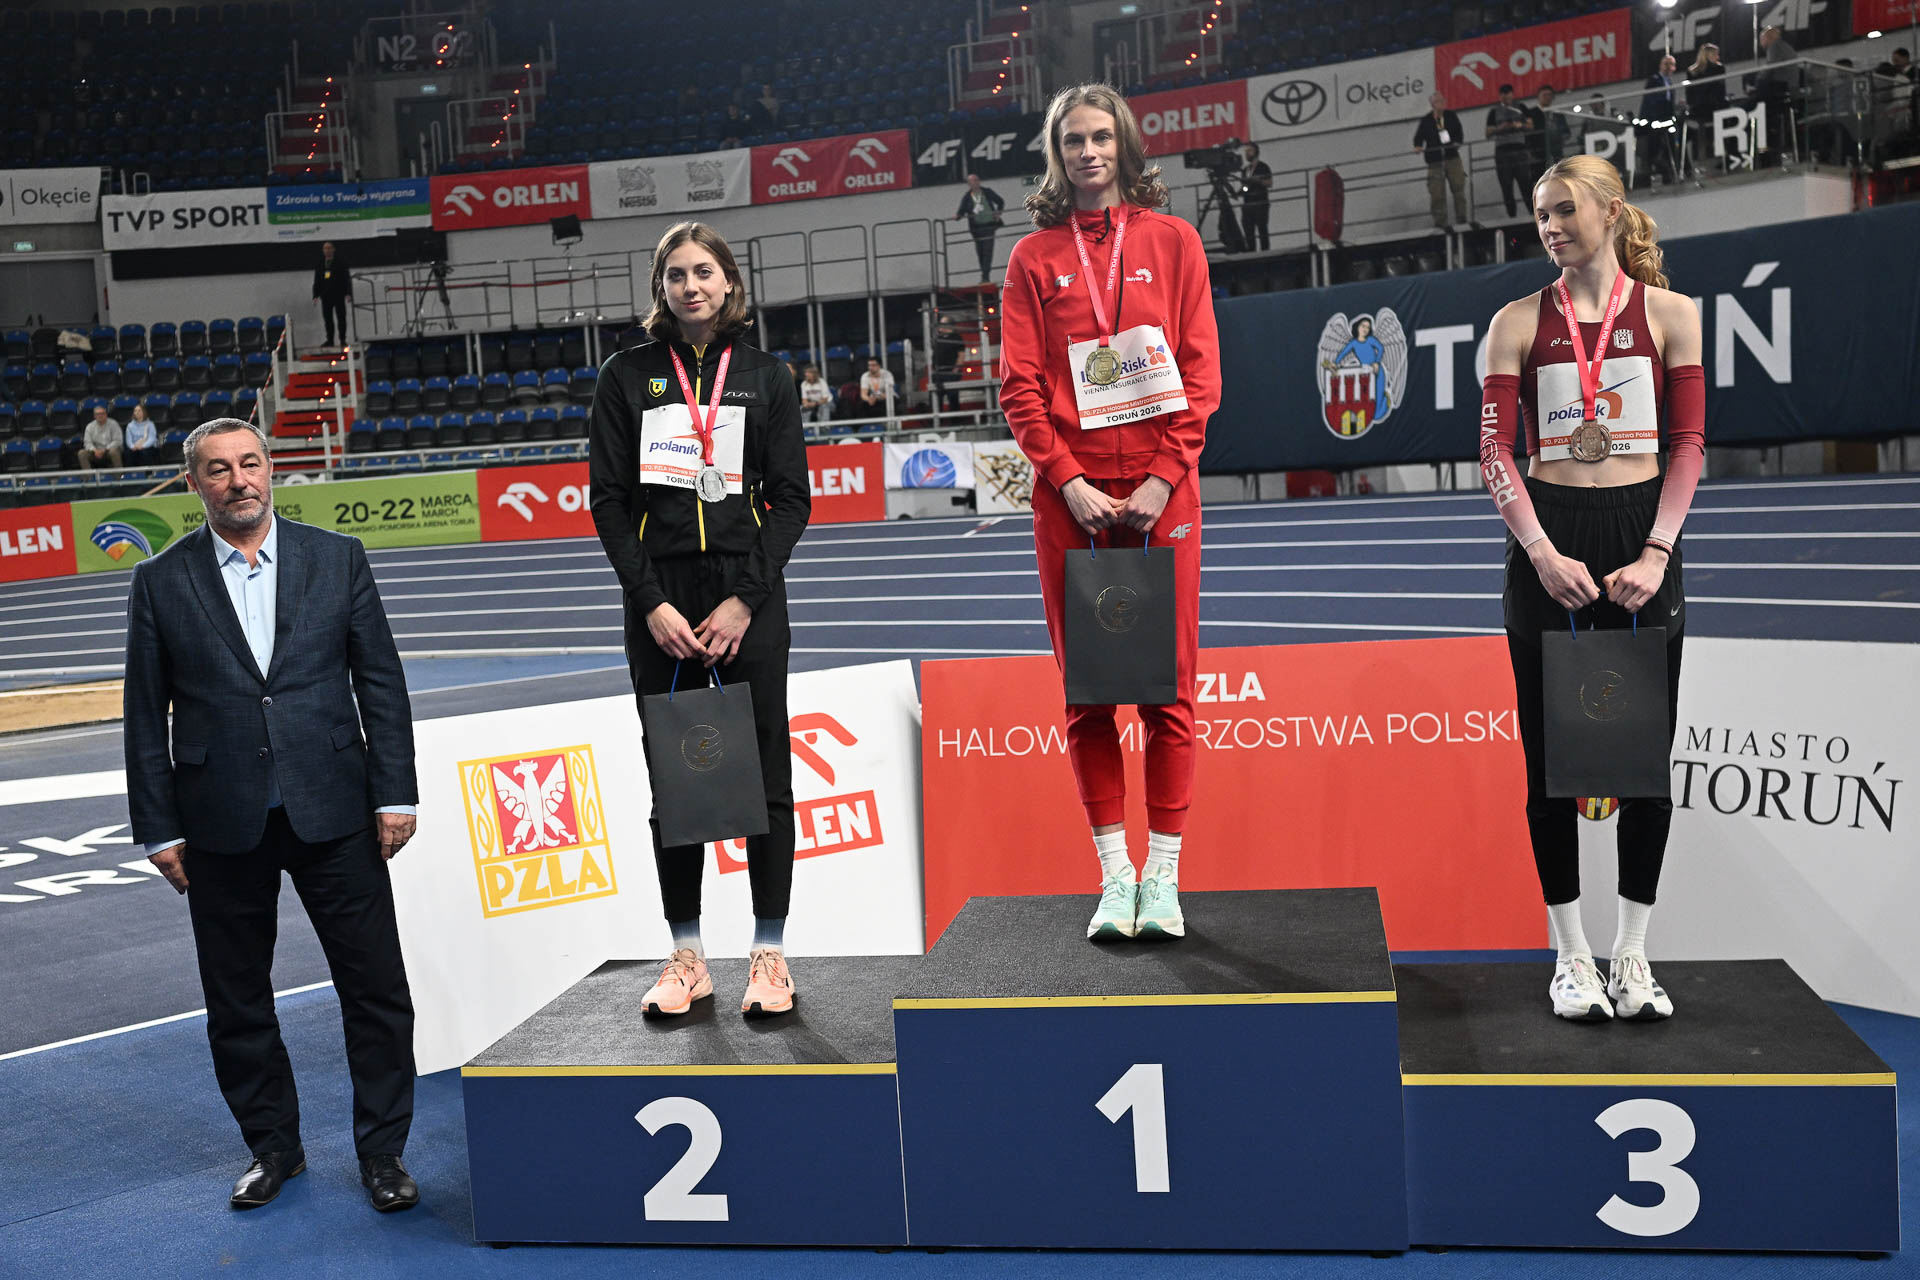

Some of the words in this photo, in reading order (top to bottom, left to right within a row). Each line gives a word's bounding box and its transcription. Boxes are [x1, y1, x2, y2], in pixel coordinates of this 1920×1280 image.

[377, 34, 417, 62] N2
[1509, 32, 1617, 76] ORLEN
[1346, 76, 1424, 106] Okęcie
[1142, 101, 1235, 136] ORLEN
[1713, 101, 1767, 157] R1
[917, 139, 962, 167] 4F
[971, 132, 1017, 161] 4F
[768, 180, 816, 197] ORLEN
[845, 171, 895, 189] ORLEN
[21, 187, 91, 208] Okęcie
[276, 193, 319, 206] Zdrowie
[322, 193, 334, 203] to
[337, 191, 368, 204] Twoja
[370, 187, 416, 202] wygrana
[493, 181, 579, 208] ORLEN
[107, 209, 165, 233] TVP
[172, 204, 264, 230] SPORT
[1084, 385, 1110, 396] VIENNA
[1111, 374, 1148, 390] INSURANCE
[1149, 370, 1172, 380] GROUP
[1106, 409, 1139, 423] TORUŃ
[1140, 404, 1162, 417] 2026
[334, 498, 416, 525] 20-22
[421, 493, 472, 508] MARCA
[421, 508, 459, 519] MARCH
[423, 520, 447, 529] ARENA
[1168, 523, 1193, 539] 4F
[1196, 671, 1265, 703] ZLA
[1386, 709, 1518, 744] POLSKI
[1687, 725, 1850, 764] MIASTO
[1672, 760, 1903, 833] TORUŃ
[484, 849, 608, 908] PZLA
[1095, 1063, 1170, 1192] 1
[634, 1096, 729, 1221] 2
[1594, 1098, 1700, 1236] 3
